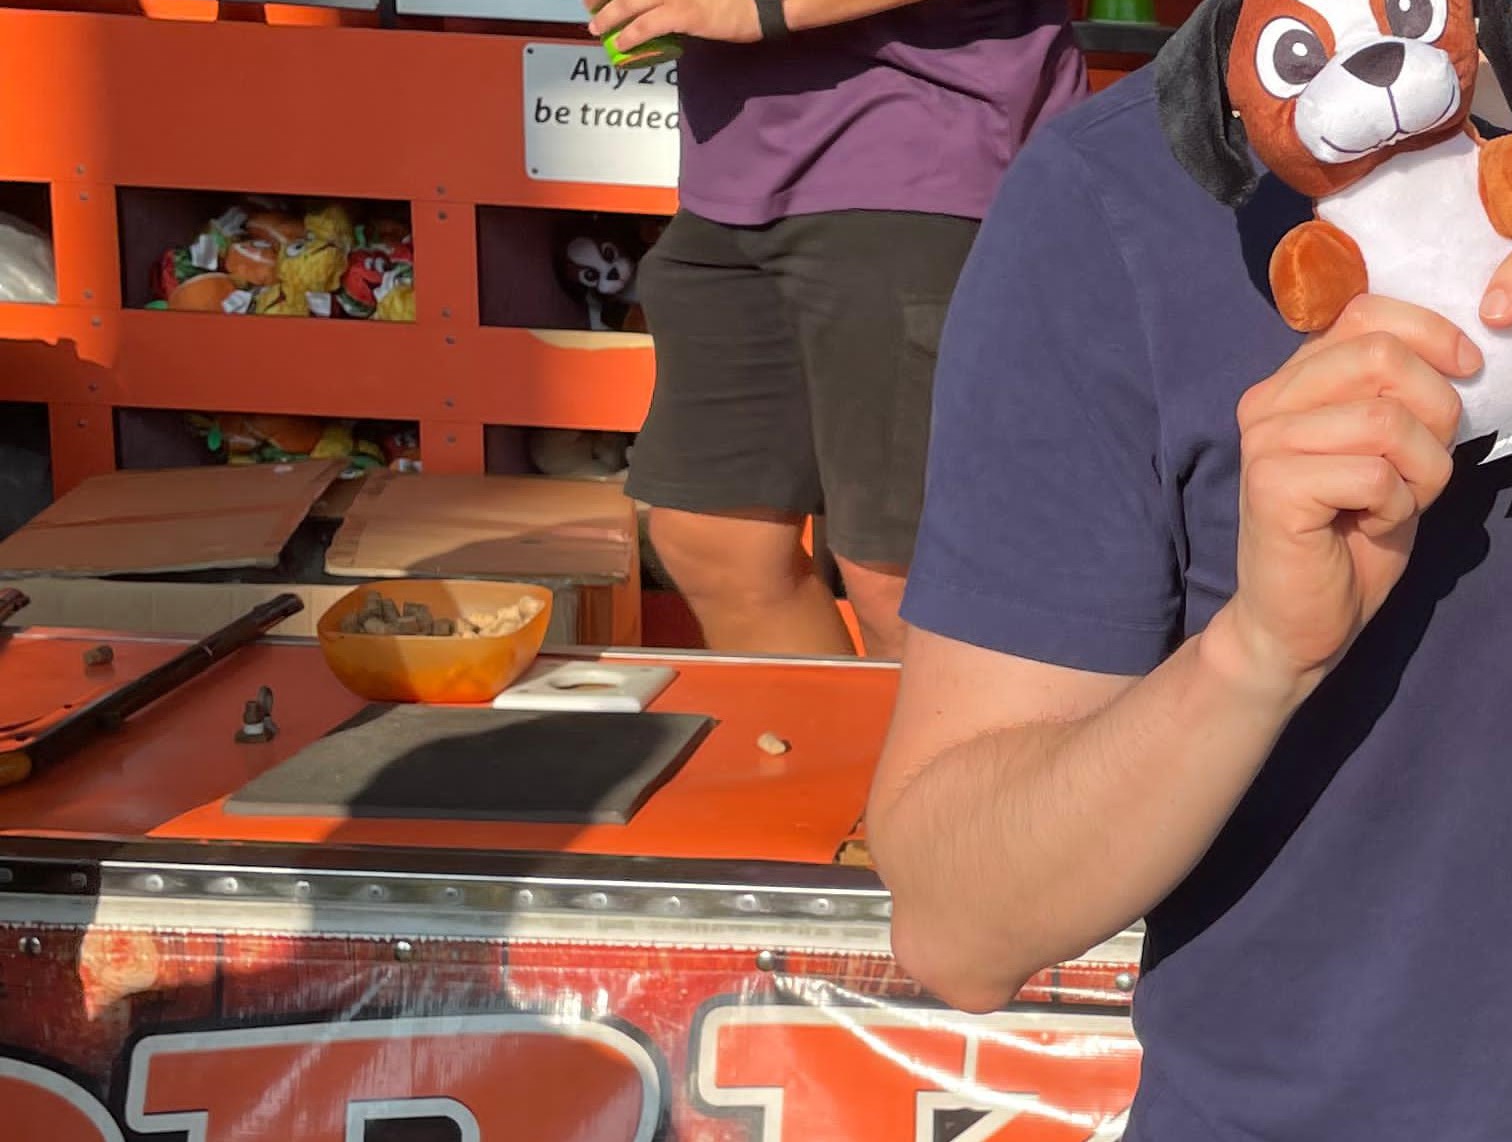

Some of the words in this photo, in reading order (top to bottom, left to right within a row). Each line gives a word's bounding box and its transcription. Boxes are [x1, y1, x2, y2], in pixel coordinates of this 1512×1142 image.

[571, 57, 629, 90] Any
[638, 65, 656, 85] 2
[534, 97, 571, 125] be
